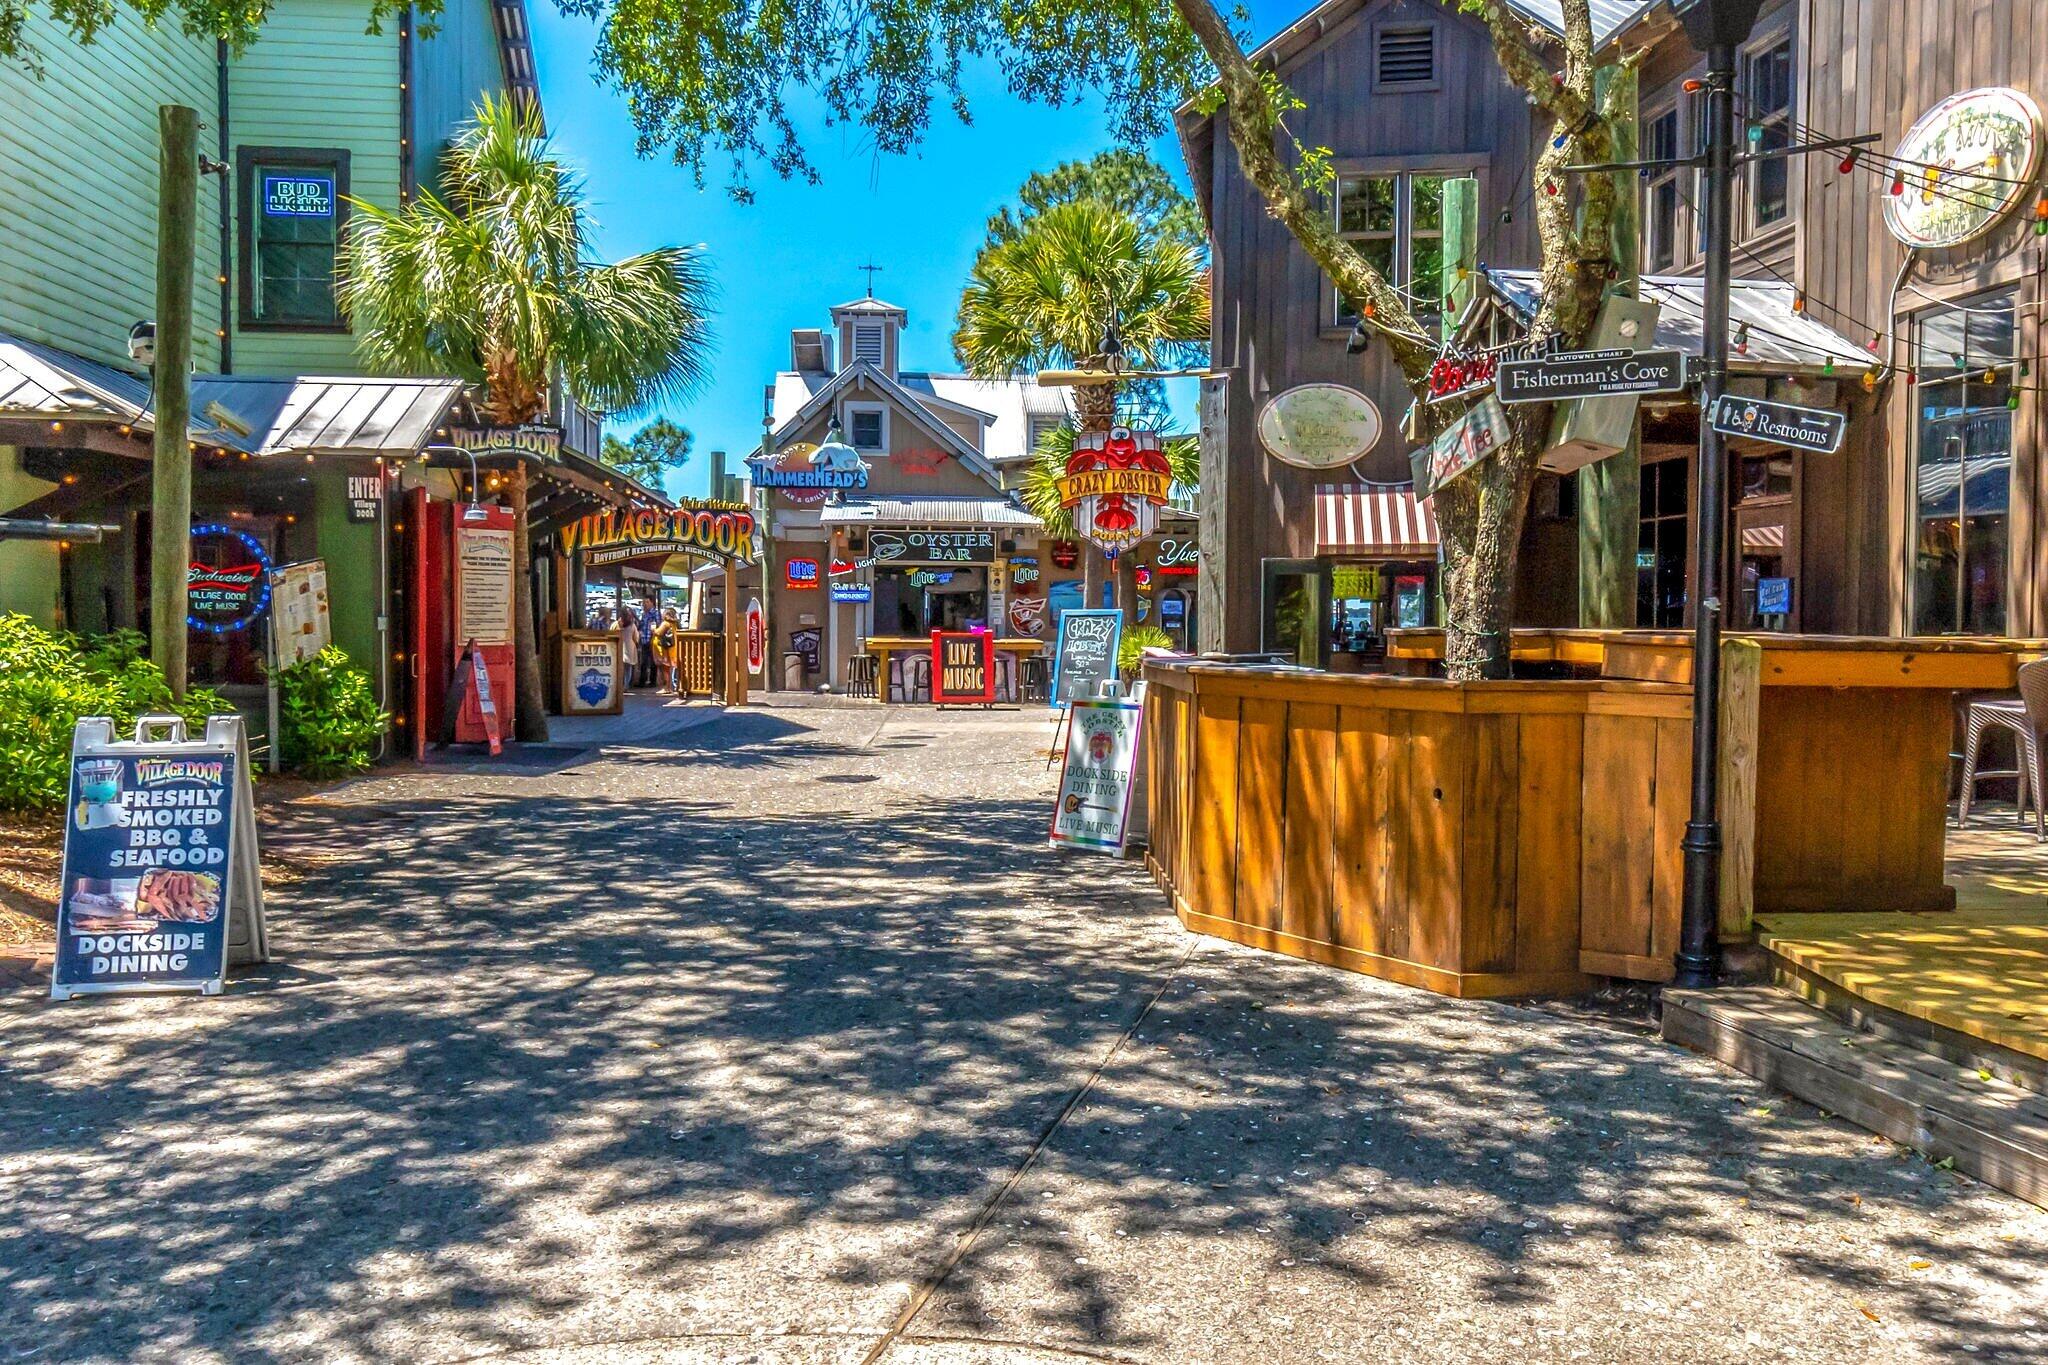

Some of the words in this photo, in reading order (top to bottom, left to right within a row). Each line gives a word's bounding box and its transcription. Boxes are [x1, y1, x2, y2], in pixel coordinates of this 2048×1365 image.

[277, 181, 320, 197] BUD
[270, 195, 328, 212] LIGHT
[1554, 352, 1596, 361] BAYTOWNE
[1597, 350, 1625, 359] WHARF
[1512, 366, 1619, 389] Fisherman's
[1622, 361, 1669, 380] Cove
[1757, 414, 1828, 445] Restrooms
[450, 426, 512, 450] VILLAGE
[515, 431, 562, 463] DOOR
[1456, 424, 1494, 461] Tree
[348, 476, 382, 499] ENTER
[1069, 473, 1108, 496] CRAZY
[1111, 471, 1161, 495] LOBSTER
[353, 499, 376, 510] Village
[679, 496, 705, 510] John
[782, 489, 795, 501] BAR
[804, 489, 828, 504] GRILLE
[560, 508, 670, 559] VILLAGE
[671, 509, 760, 566] DOOR
[908, 533, 993, 547] OYSTER
[1091, 528, 1141, 541] POPPY'S
[593, 548, 630, 564] BAYFRONT
[631, 544, 676, 556] RESTAURANT
[685, 546, 726, 565] NIGHTCLUB
[854, 558, 877, 569] LIGHT
[928, 547, 972, 560] BAR
[789, 561, 816, 579] Lite
[910, 571, 936, 588] Lite
[1013, 567, 1040, 584] Lite
[189, 591, 222, 600] VILLAGE
[195, 602, 213, 610] LIVE
[215, 602, 240, 610] MUSIC
[750, 618, 758, 641] Stripe
[1066, 617, 1116, 642] CRAZY
[580, 644, 607, 655] LIVE
[750, 641, 758, 659] Red
[948, 643, 976, 665] LIVE
[575, 656, 612, 667] MUSIC
[943, 667, 984, 690] MUSIC
[1081, 713, 1098, 728] THE
[1101, 711, 1127, 730] CRAZY
[1083, 718, 1123, 739] LOBSTER
[134, 761, 185, 786] VILLAGE
[186, 761, 224, 786] DOOR
[121, 788, 225, 808] FRESHLY
[1072, 781, 1117, 797] DINING
[118, 808, 223, 828] SMOKED
[1059, 816, 1084, 831] LIVE
[1085, 820, 1119, 836] MUSIC
[129, 828, 182, 847] BBQ
[188, 827, 209, 845] &
[109, 847, 225, 867] SEAFOOD
[78, 932, 205, 955] DOCKSIDE
[92, 953, 189, 975] DINING
